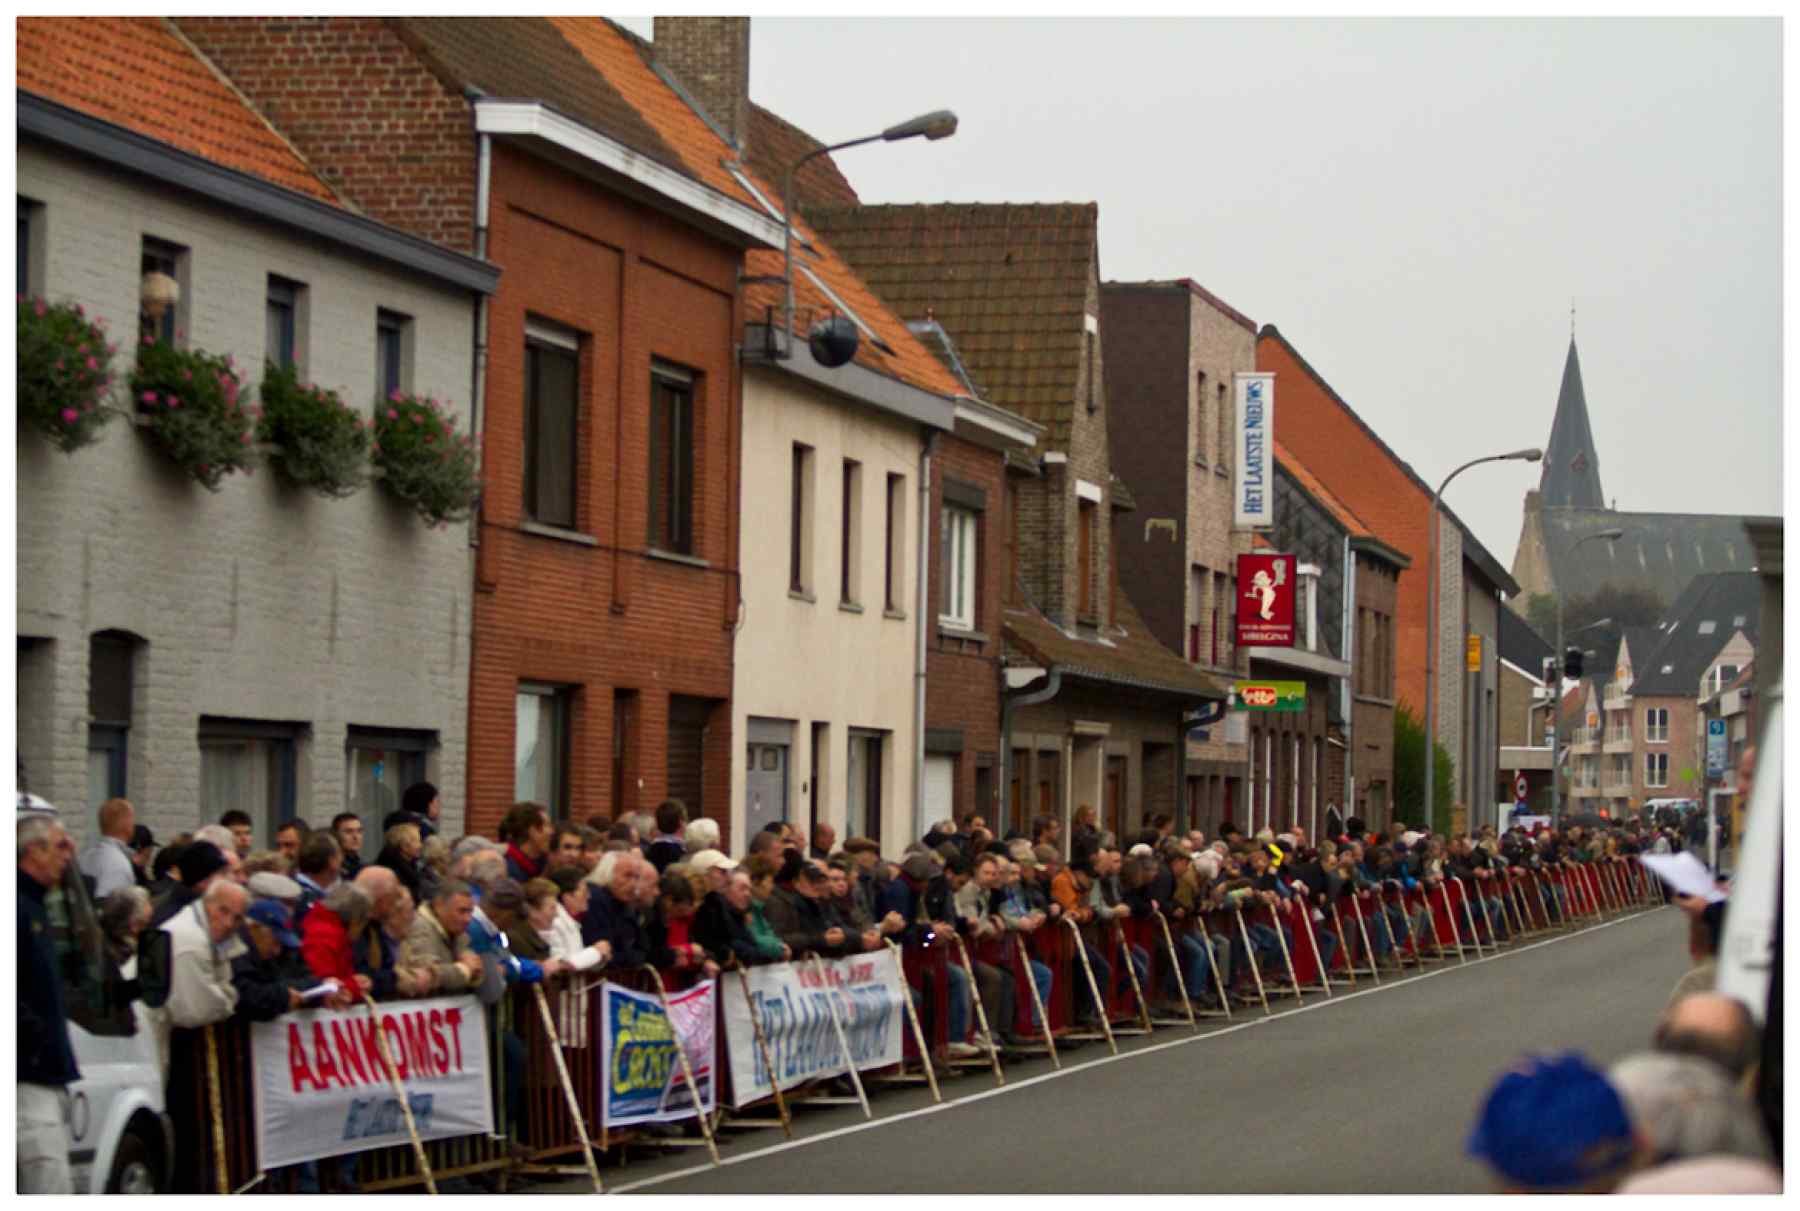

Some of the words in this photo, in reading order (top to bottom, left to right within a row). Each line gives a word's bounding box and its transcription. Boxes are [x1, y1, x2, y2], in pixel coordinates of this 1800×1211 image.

[1244, 380, 1263, 429] NIEUWS
[1243, 432, 1263, 486] LAATSTE
[1243, 488, 1263, 513] HET
[288, 1008, 463, 1093] AANKOMST
